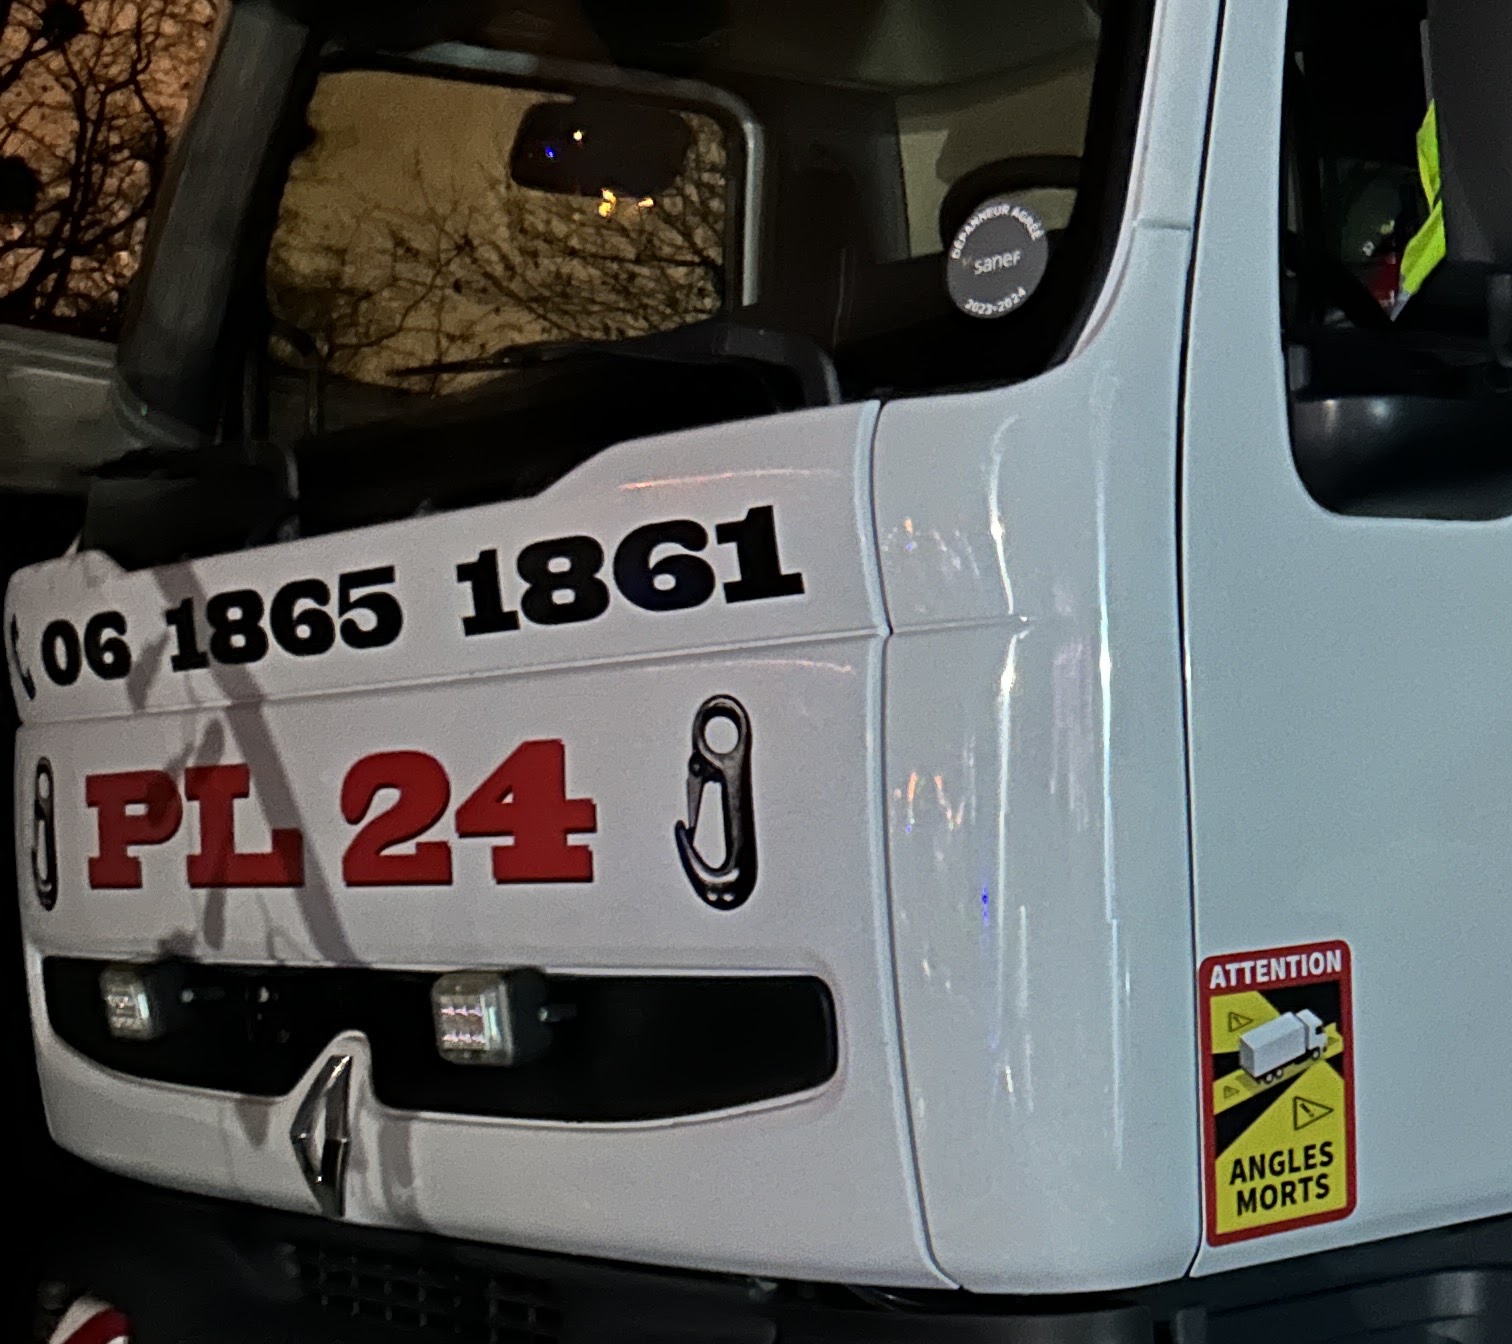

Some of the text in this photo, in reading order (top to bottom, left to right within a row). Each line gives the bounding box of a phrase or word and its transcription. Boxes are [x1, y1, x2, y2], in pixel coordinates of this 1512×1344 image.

[973, 250, 1021, 275] sanef
[40, 506, 805, 686] 06 1865 1861
[85, 739, 598, 889] PL 24
[1209, 950, 1342, 989] ATTENTION
[1229, 1140, 1334, 1186] ANGLES
[1236, 1173, 1330, 1217] MORTS
